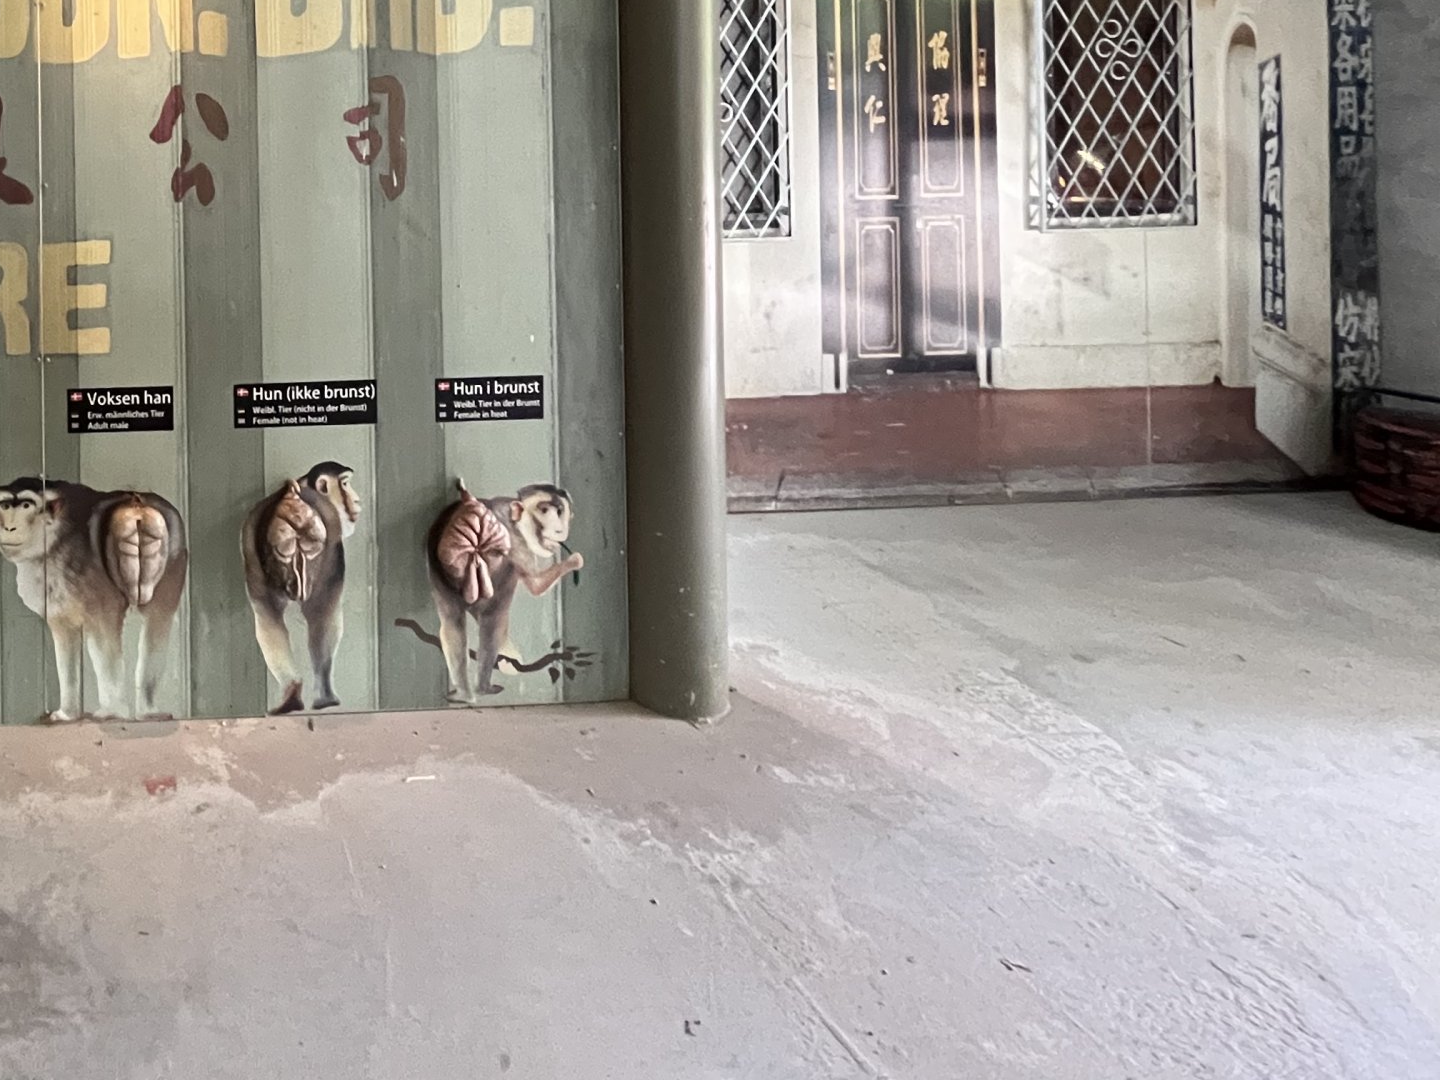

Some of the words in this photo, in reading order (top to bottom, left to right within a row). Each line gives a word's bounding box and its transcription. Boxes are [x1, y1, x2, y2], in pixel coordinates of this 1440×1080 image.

[252, 387, 282, 401] Hun
[286, 385, 321, 402] (ikke
[324, 383, 376, 400] brunst)
[454, 381, 483, 395] Hun
[486, 381, 491, 394] i
[494, 380, 540, 394] brunst
[86, 391, 140, 406] Voksen
[144, 390, 171, 404] han
[150, 410, 165, 418] Tier
[278, 405, 292, 413] Tier
[293, 405, 316, 414] (nicht
[326, 404, 338, 412] der
[87, 421, 109, 430] Adult
[252, 416, 281, 425] Female
[282, 416, 298, 425] (not
